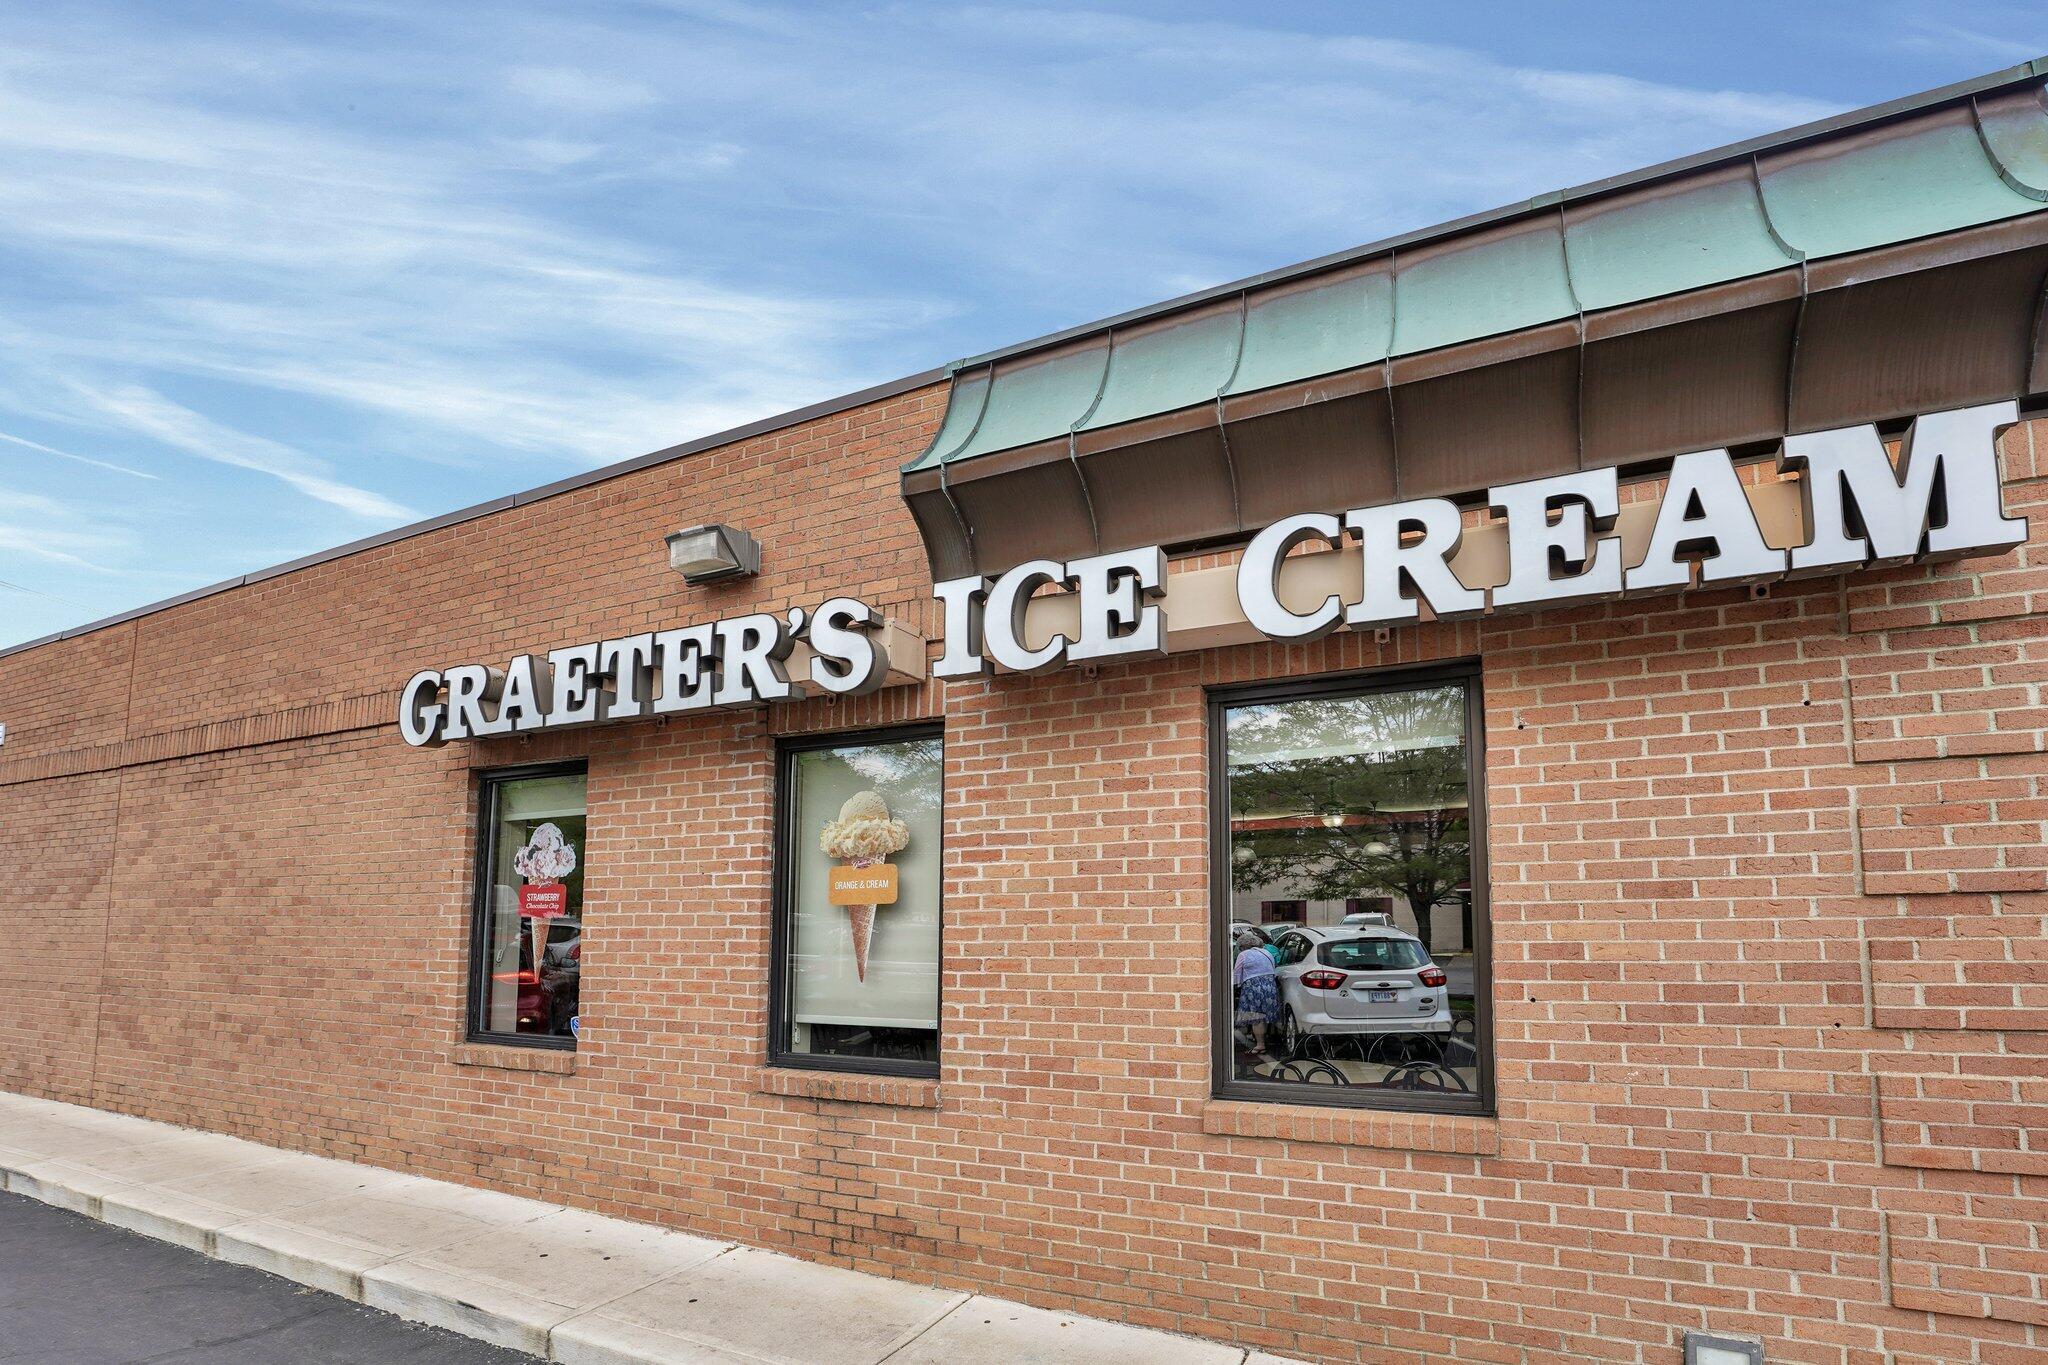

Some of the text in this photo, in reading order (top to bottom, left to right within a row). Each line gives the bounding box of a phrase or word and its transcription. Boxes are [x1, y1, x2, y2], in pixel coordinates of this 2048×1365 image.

[400, 400, 2027, 746] GRAETER'S ICE CREAM
[834, 879, 889, 890] ORANGE & CREAM
[526, 893, 560, 902] STRAWBERRY
